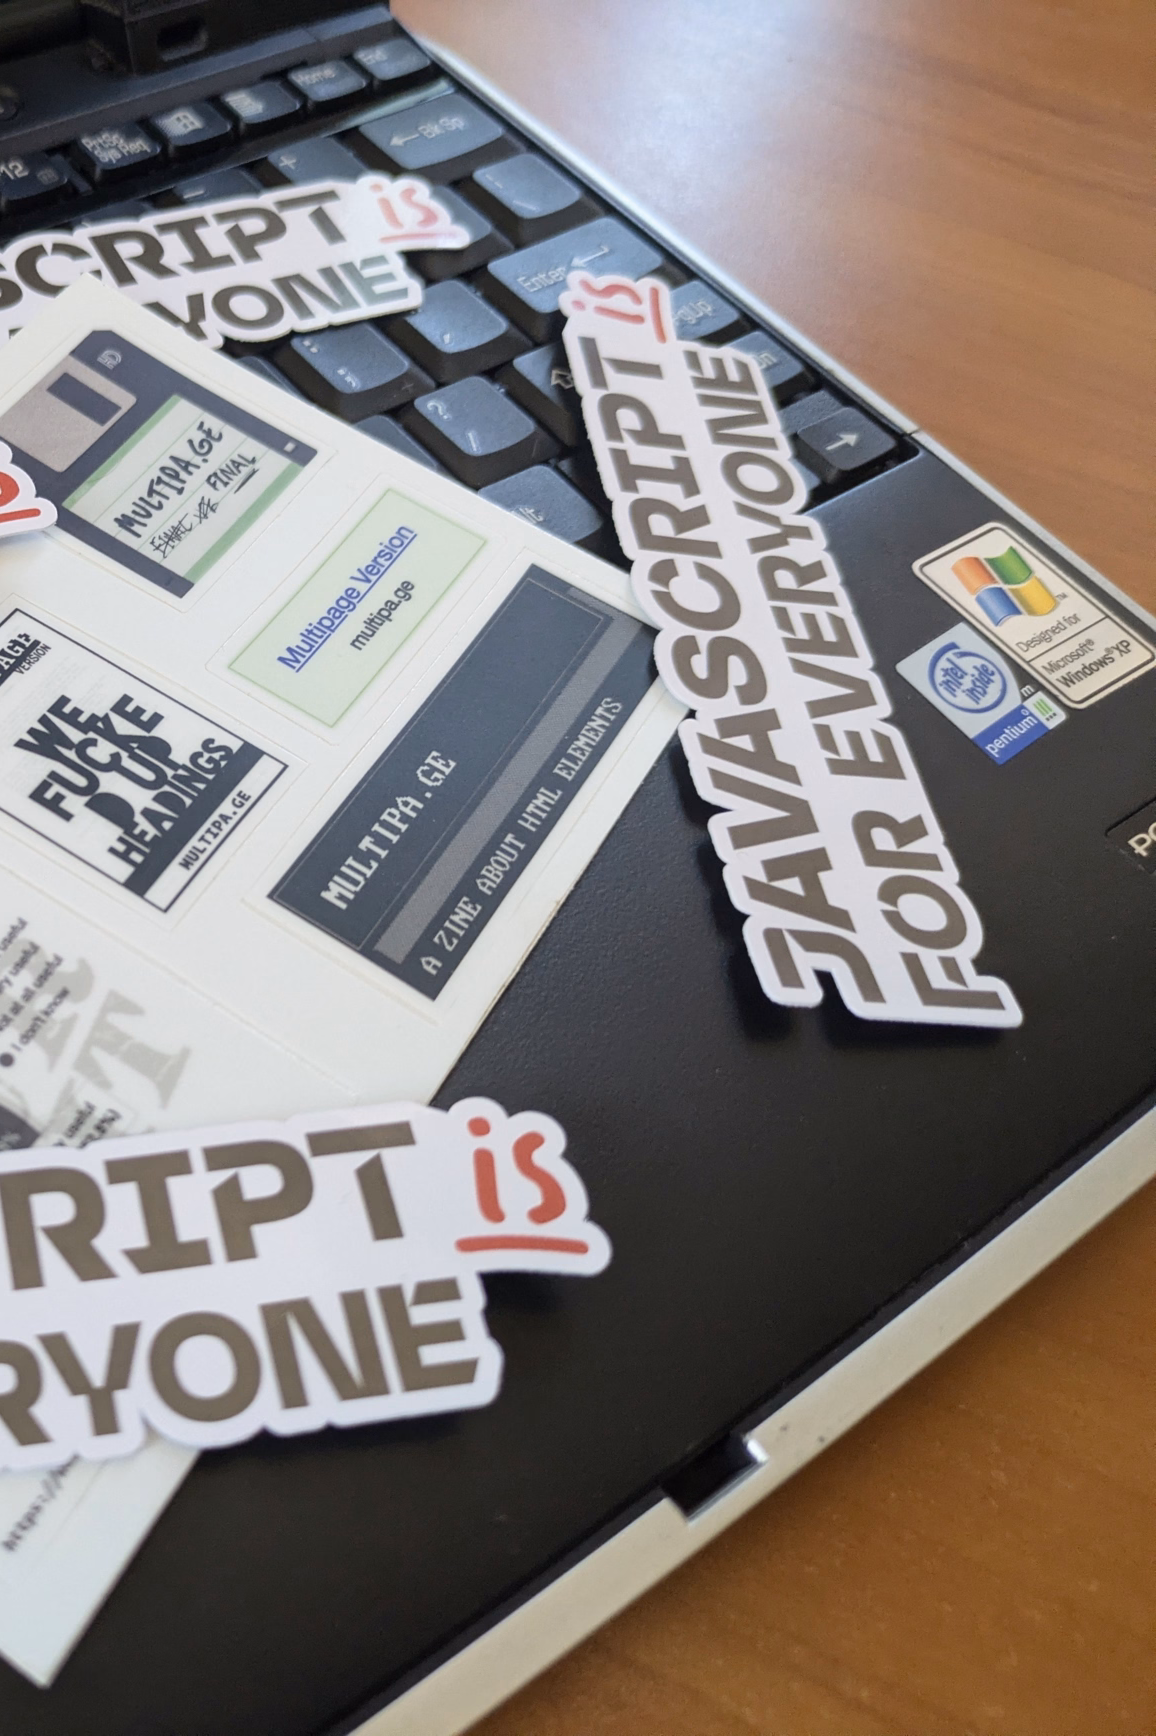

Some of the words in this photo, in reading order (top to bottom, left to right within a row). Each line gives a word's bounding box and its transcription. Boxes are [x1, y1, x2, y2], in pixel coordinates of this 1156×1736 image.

[368, 183, 440, 229] is
[517, 265, 566, 293] Enter
[571, 278, 645, 325] is
[673, 298, 714, 324] gUp
[113, 420, 224, 539] MULTIPA.GE
[205, 453, 257, 492] FINAL
[682, 350, 907, 780] EVERYONE
[276, 585, 362, 671] Multipage
[349, 524, 417, 586] Version
[348, 579, 416, 651] multipa.ge
[13, 643, 52, 675] VERSION
[1015, 618, 1067, 653] Designed
[1065, 612, 1082, 629] for
[577, 335, 887, 1005] JAVASCRIPT
[938, 656, 968, 698] intel
[961, 663, 996, 706] inside
[12, 694, 97, 756] WE
[107, 737, 234, 868] HEADINGS
[178, 789, 252, 871] MULTIPA.GE
[320, 749, 457, 911] MULTIPA.GE
[419, 955, 443, 976] A
[433, 895, 482, 953] ZINE
[474, 832, 528, 895] ABOUT
[517, 785, 564, 833] HTML
[552, 696, 624, 782] ELEMENTS
[851, 809, 1006, 1011] FOR
[8, 940, 41, 977] useful
[9, 999, 24, 1016] at
[20, 985, 37, 1004] all
[32, 953, 64, 989] useful
[18, 1013, 49, 1047] don't
[43, 986, 71, 1023] know
[467, 1115, 568, 1225] is
